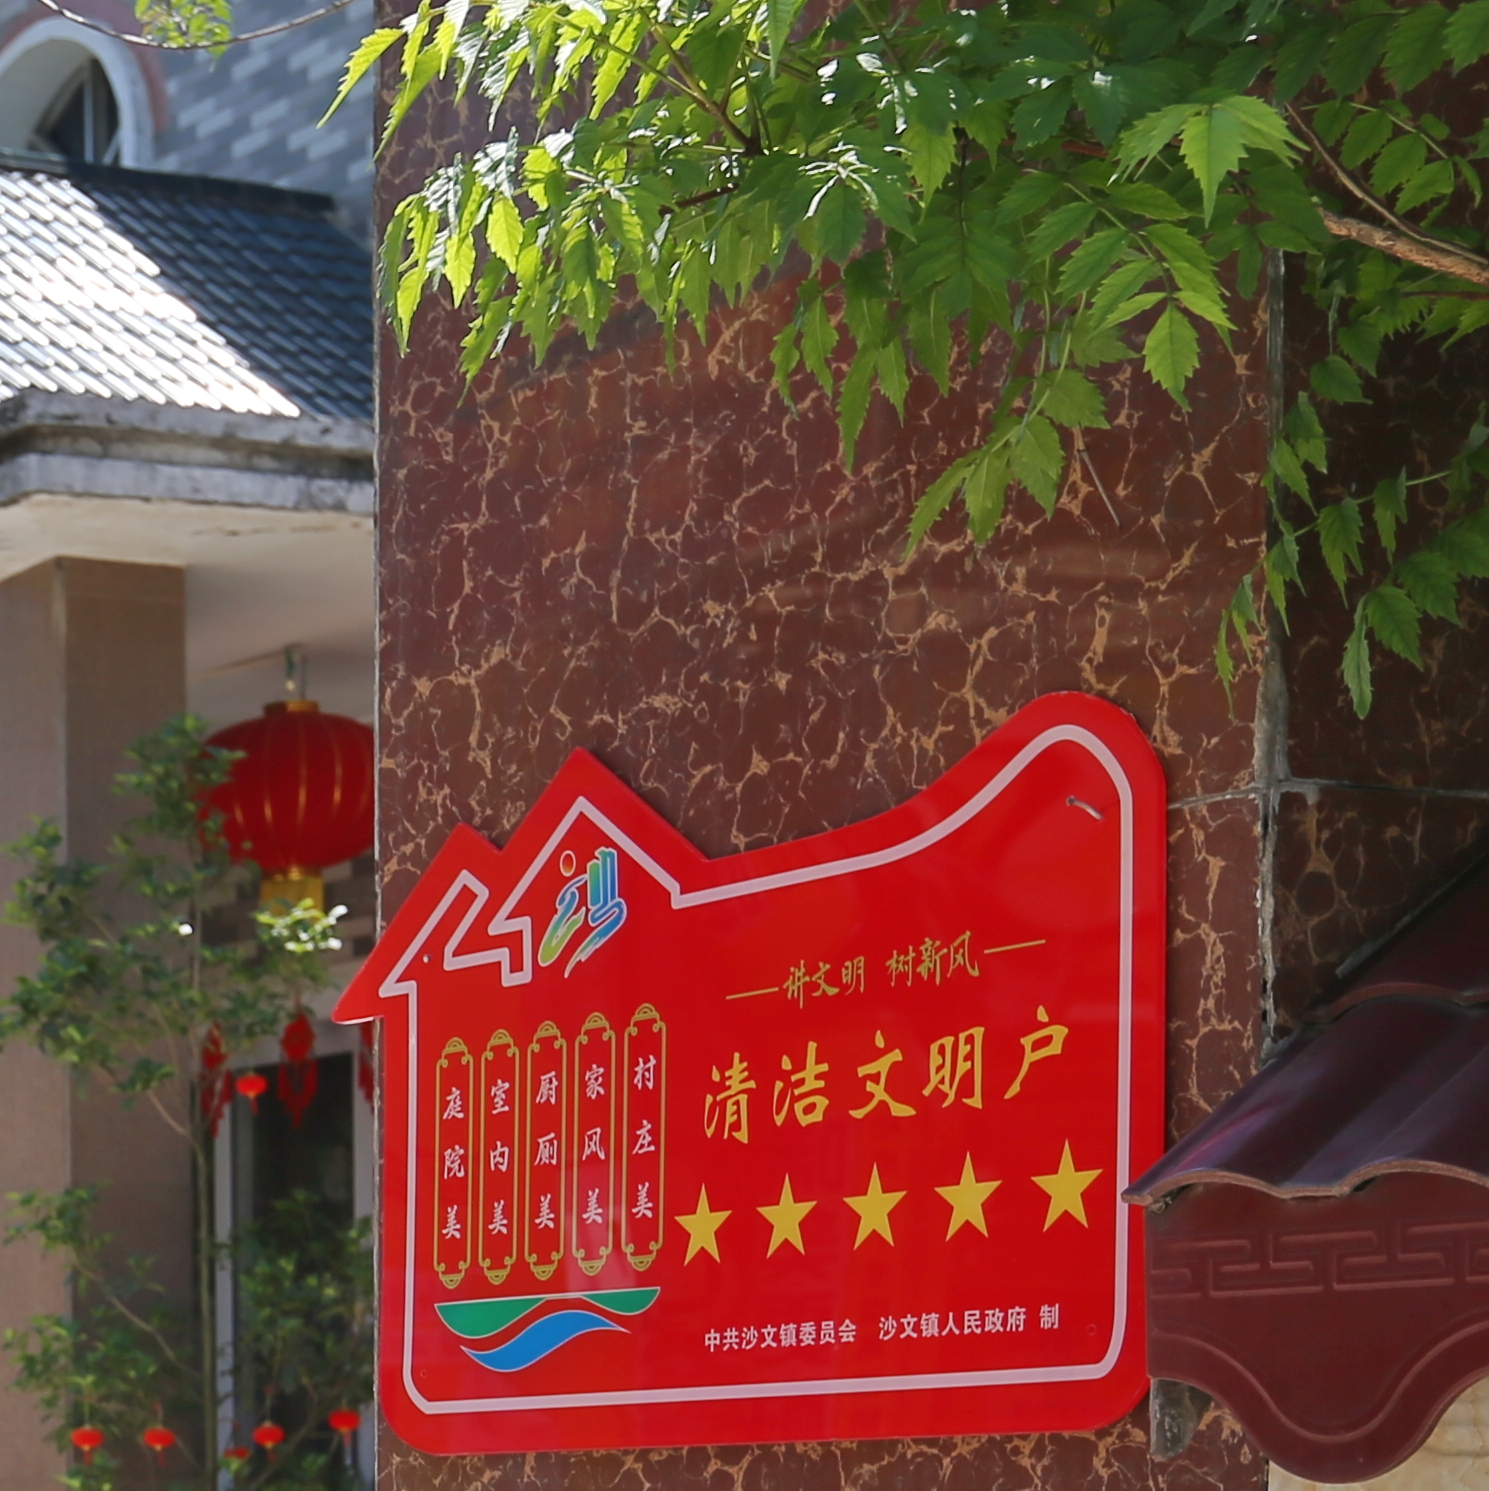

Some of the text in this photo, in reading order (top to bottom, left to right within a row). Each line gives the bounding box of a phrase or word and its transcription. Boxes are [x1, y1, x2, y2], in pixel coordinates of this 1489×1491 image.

[782, 931, 980, 1009] 讲文明 树新风
[534, 1071, 559, 1229] 厨厕美
[582, 1064, 605, 1224] 家风美
[631, 1055, 656, 1219] 村庄美
[704, 1005, 1069, 1144] 清洁文明户
[442, 1087, 465, 1240] 庭院美
[488, 1079, 510, 1235] 室内美
[704, 1303, 1060, 1352] 中共沙文镇委员会 沙文镇人民政府 制
